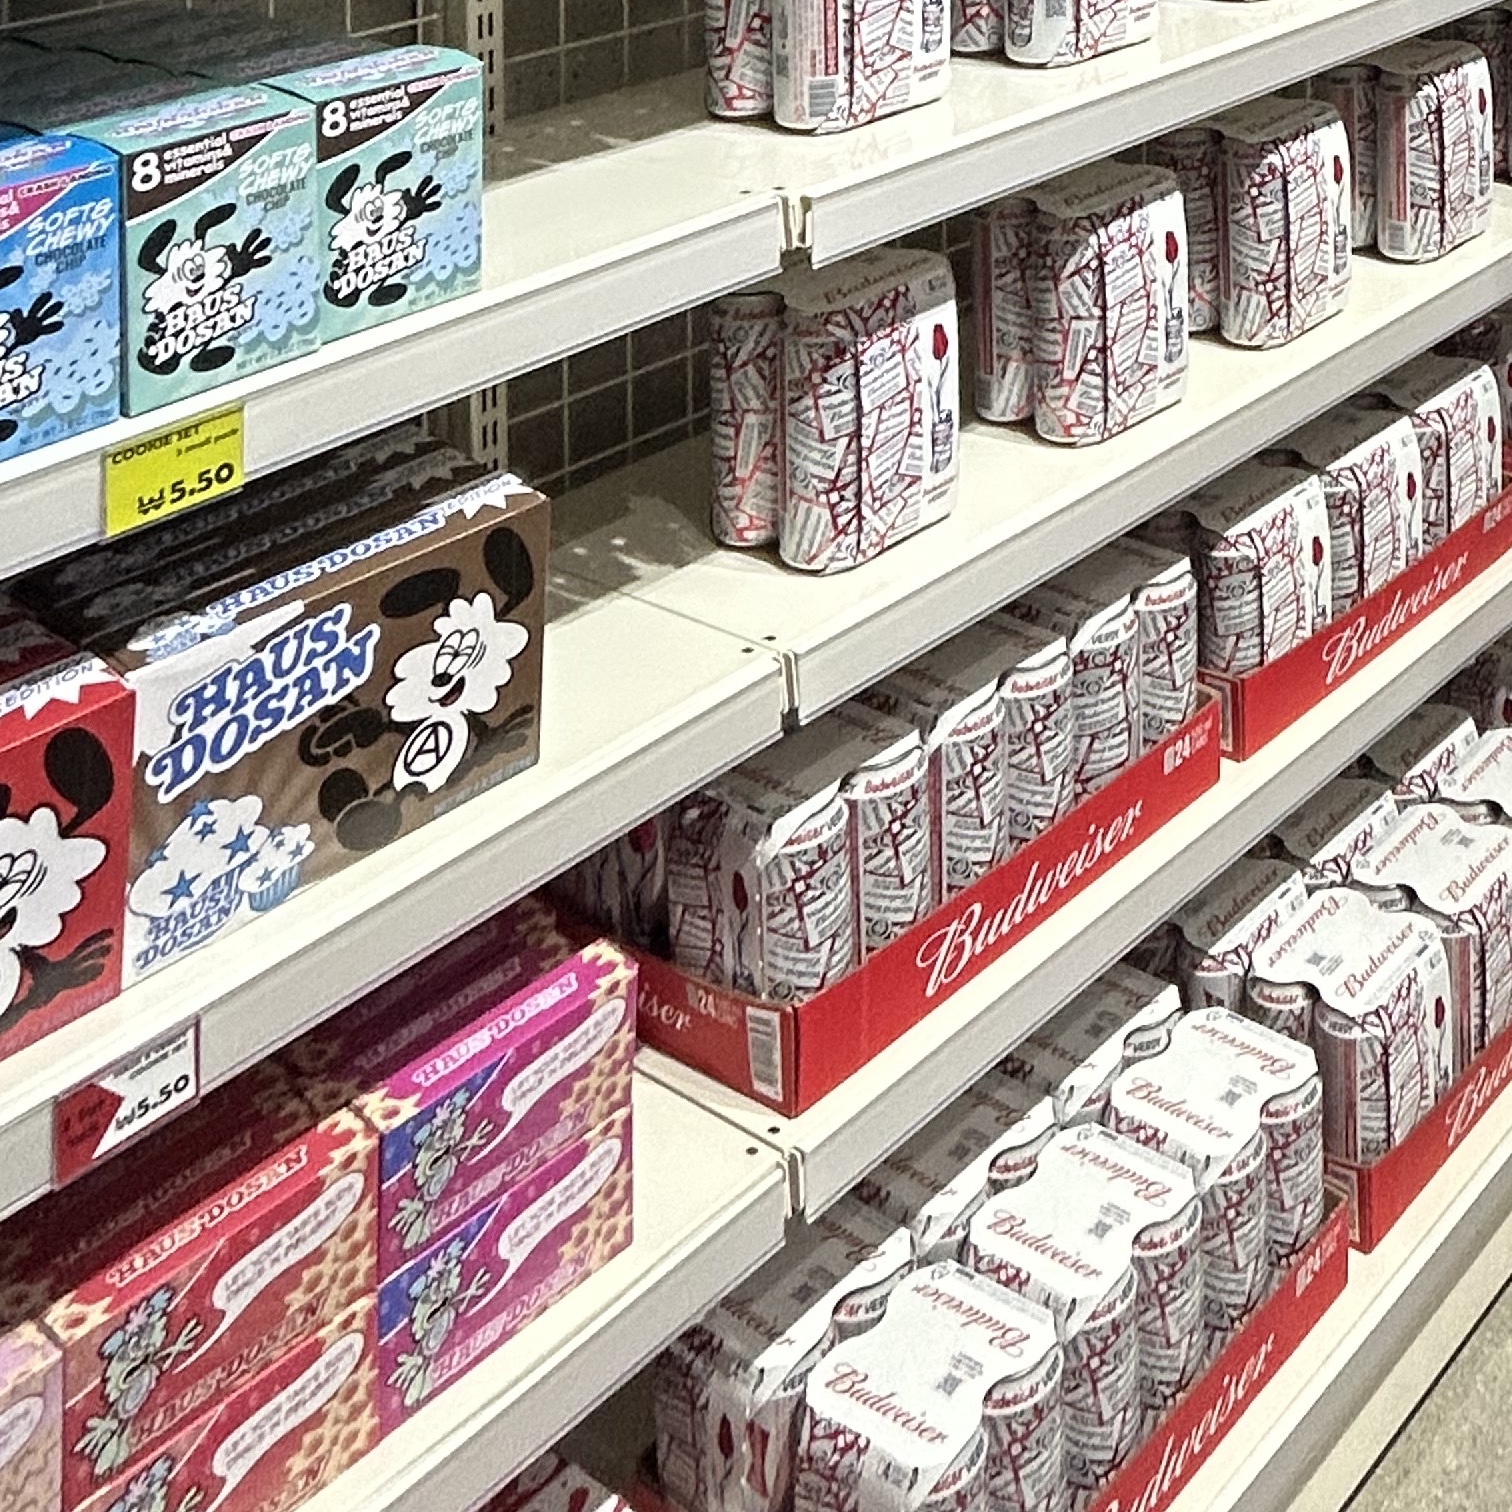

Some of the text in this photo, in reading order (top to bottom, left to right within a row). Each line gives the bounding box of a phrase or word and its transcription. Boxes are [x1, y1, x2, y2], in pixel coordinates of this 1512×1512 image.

[322, 101, 348, 138] 8
[414, 113, 479, 144] CHEWY
[131, 152, 162, 192] 8
[239, 157, 314, 197] CHEWY
[26, 212, 114, 256] CHEWY
[343, 225, 416, 272] HAUS
[333, 240, 426, 300] DOSAN
[148, 298, 257, 366] DOSAN
[162, 283, 243, 336] HAUS
[210, 560, 317, 615] HAUS
[319, 511, 443, 572] DOSAN
[1322, 551, 1469, 686] Budweiser
[175, 608, 345, 735] HAUS
[151, 630, 374, 796] DOSAN
[917, 795, 1144, 996] Budweiser
[1440, 837, 1511, 903] Budweiser
[135, 904, 232, 970] DOSAN
[147, 886, 225, 943] HAUS
[1335, 922, 1415, 998] Budweiser
[413, 1030, 488, 1085] HAUS
[1125, 1076, 1234, 1140] Budweiser
[106, 1219, 202, 1287] HAUS
[986, 1208, 1102, 1278] Budweiser
[824, 1362, 949, 1444] Budweiser
